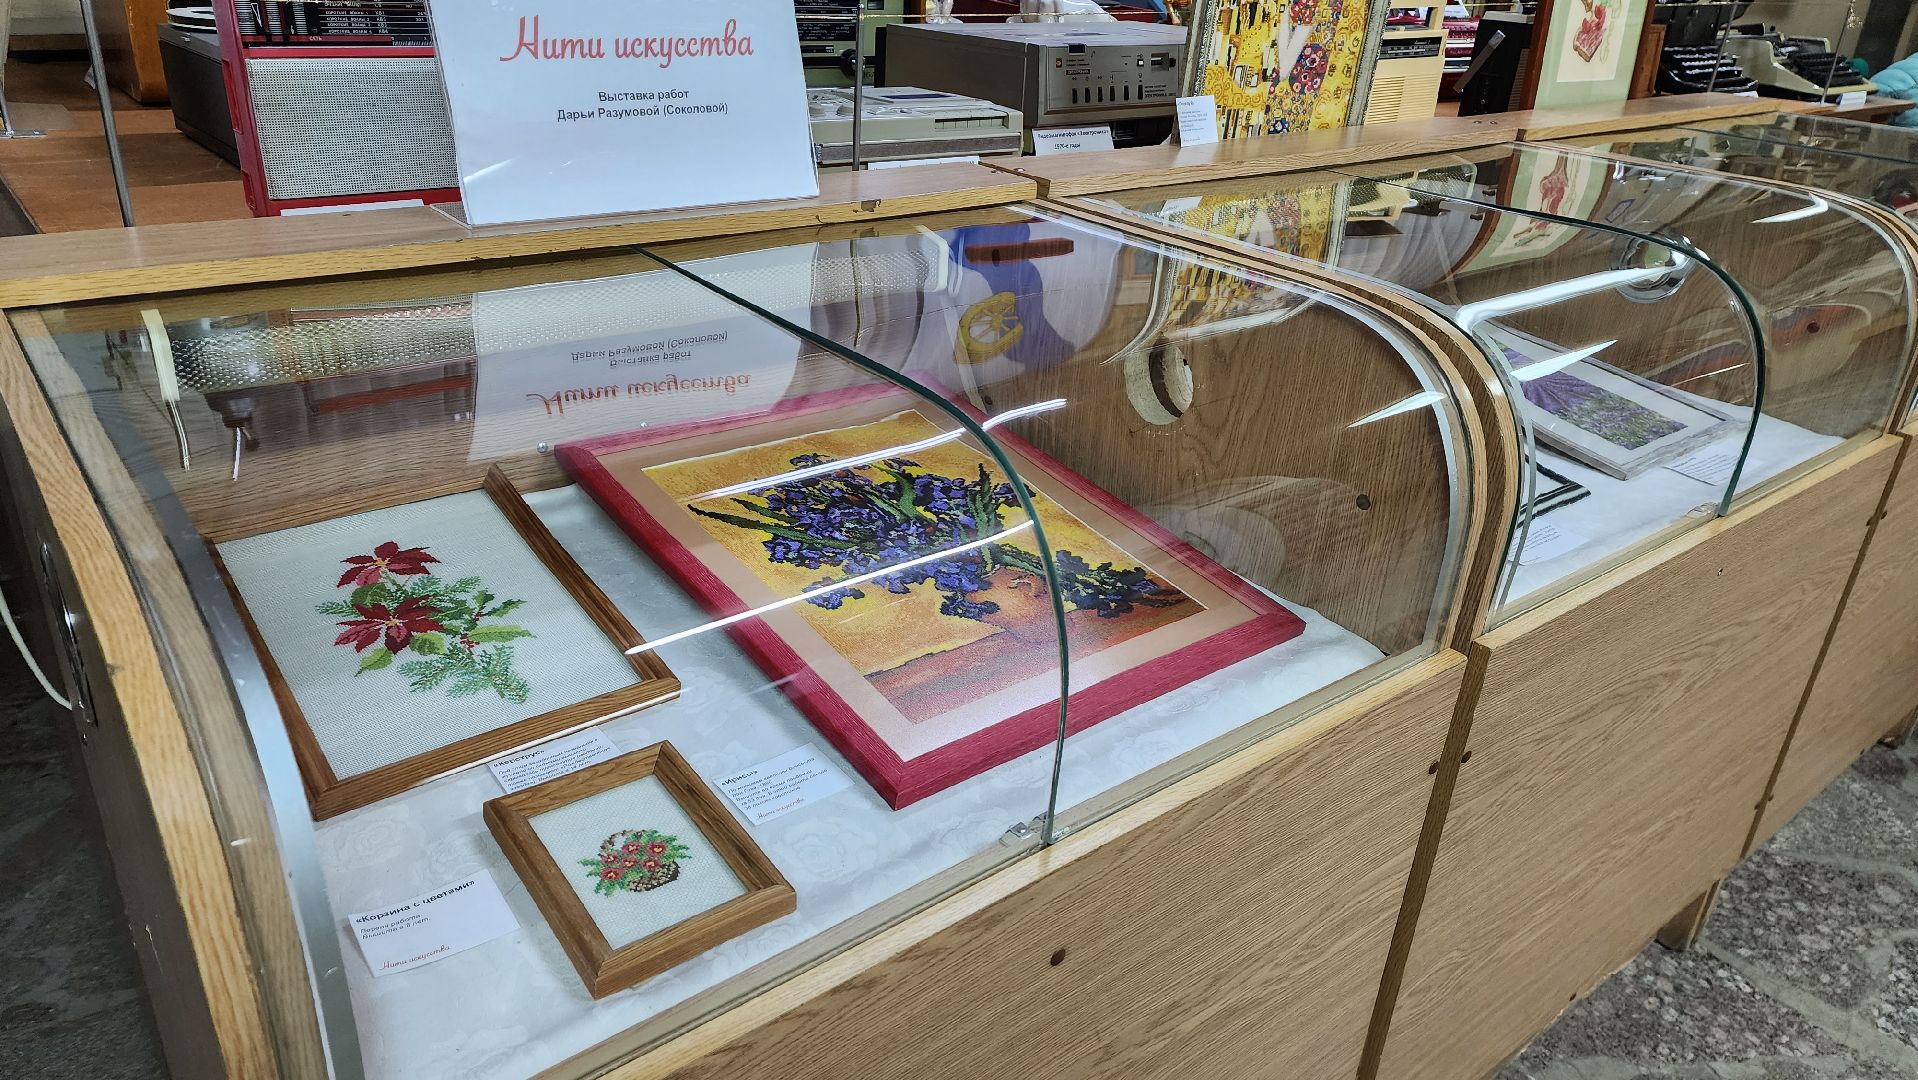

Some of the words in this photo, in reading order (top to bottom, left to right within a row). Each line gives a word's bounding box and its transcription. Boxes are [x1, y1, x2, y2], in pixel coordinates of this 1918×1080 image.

[499, 14, 606, 62] Нити
[614, 18, 754, 69] искусства
[598, 89, 655, 102] Выставка
[657, 87, 690, 102] работ
[557, 107, 595, 123] Дарьи
[598, 104, 660, 119] Разумовой
[663, 101, 729, 117] (Соколовой)
[721, 769, 758, 786] «Ирисы»
[356, 904, 411, 924] «Корзина
[422, 880, 476, 906] цветами»
[408, 944, 451, 964] искусства
